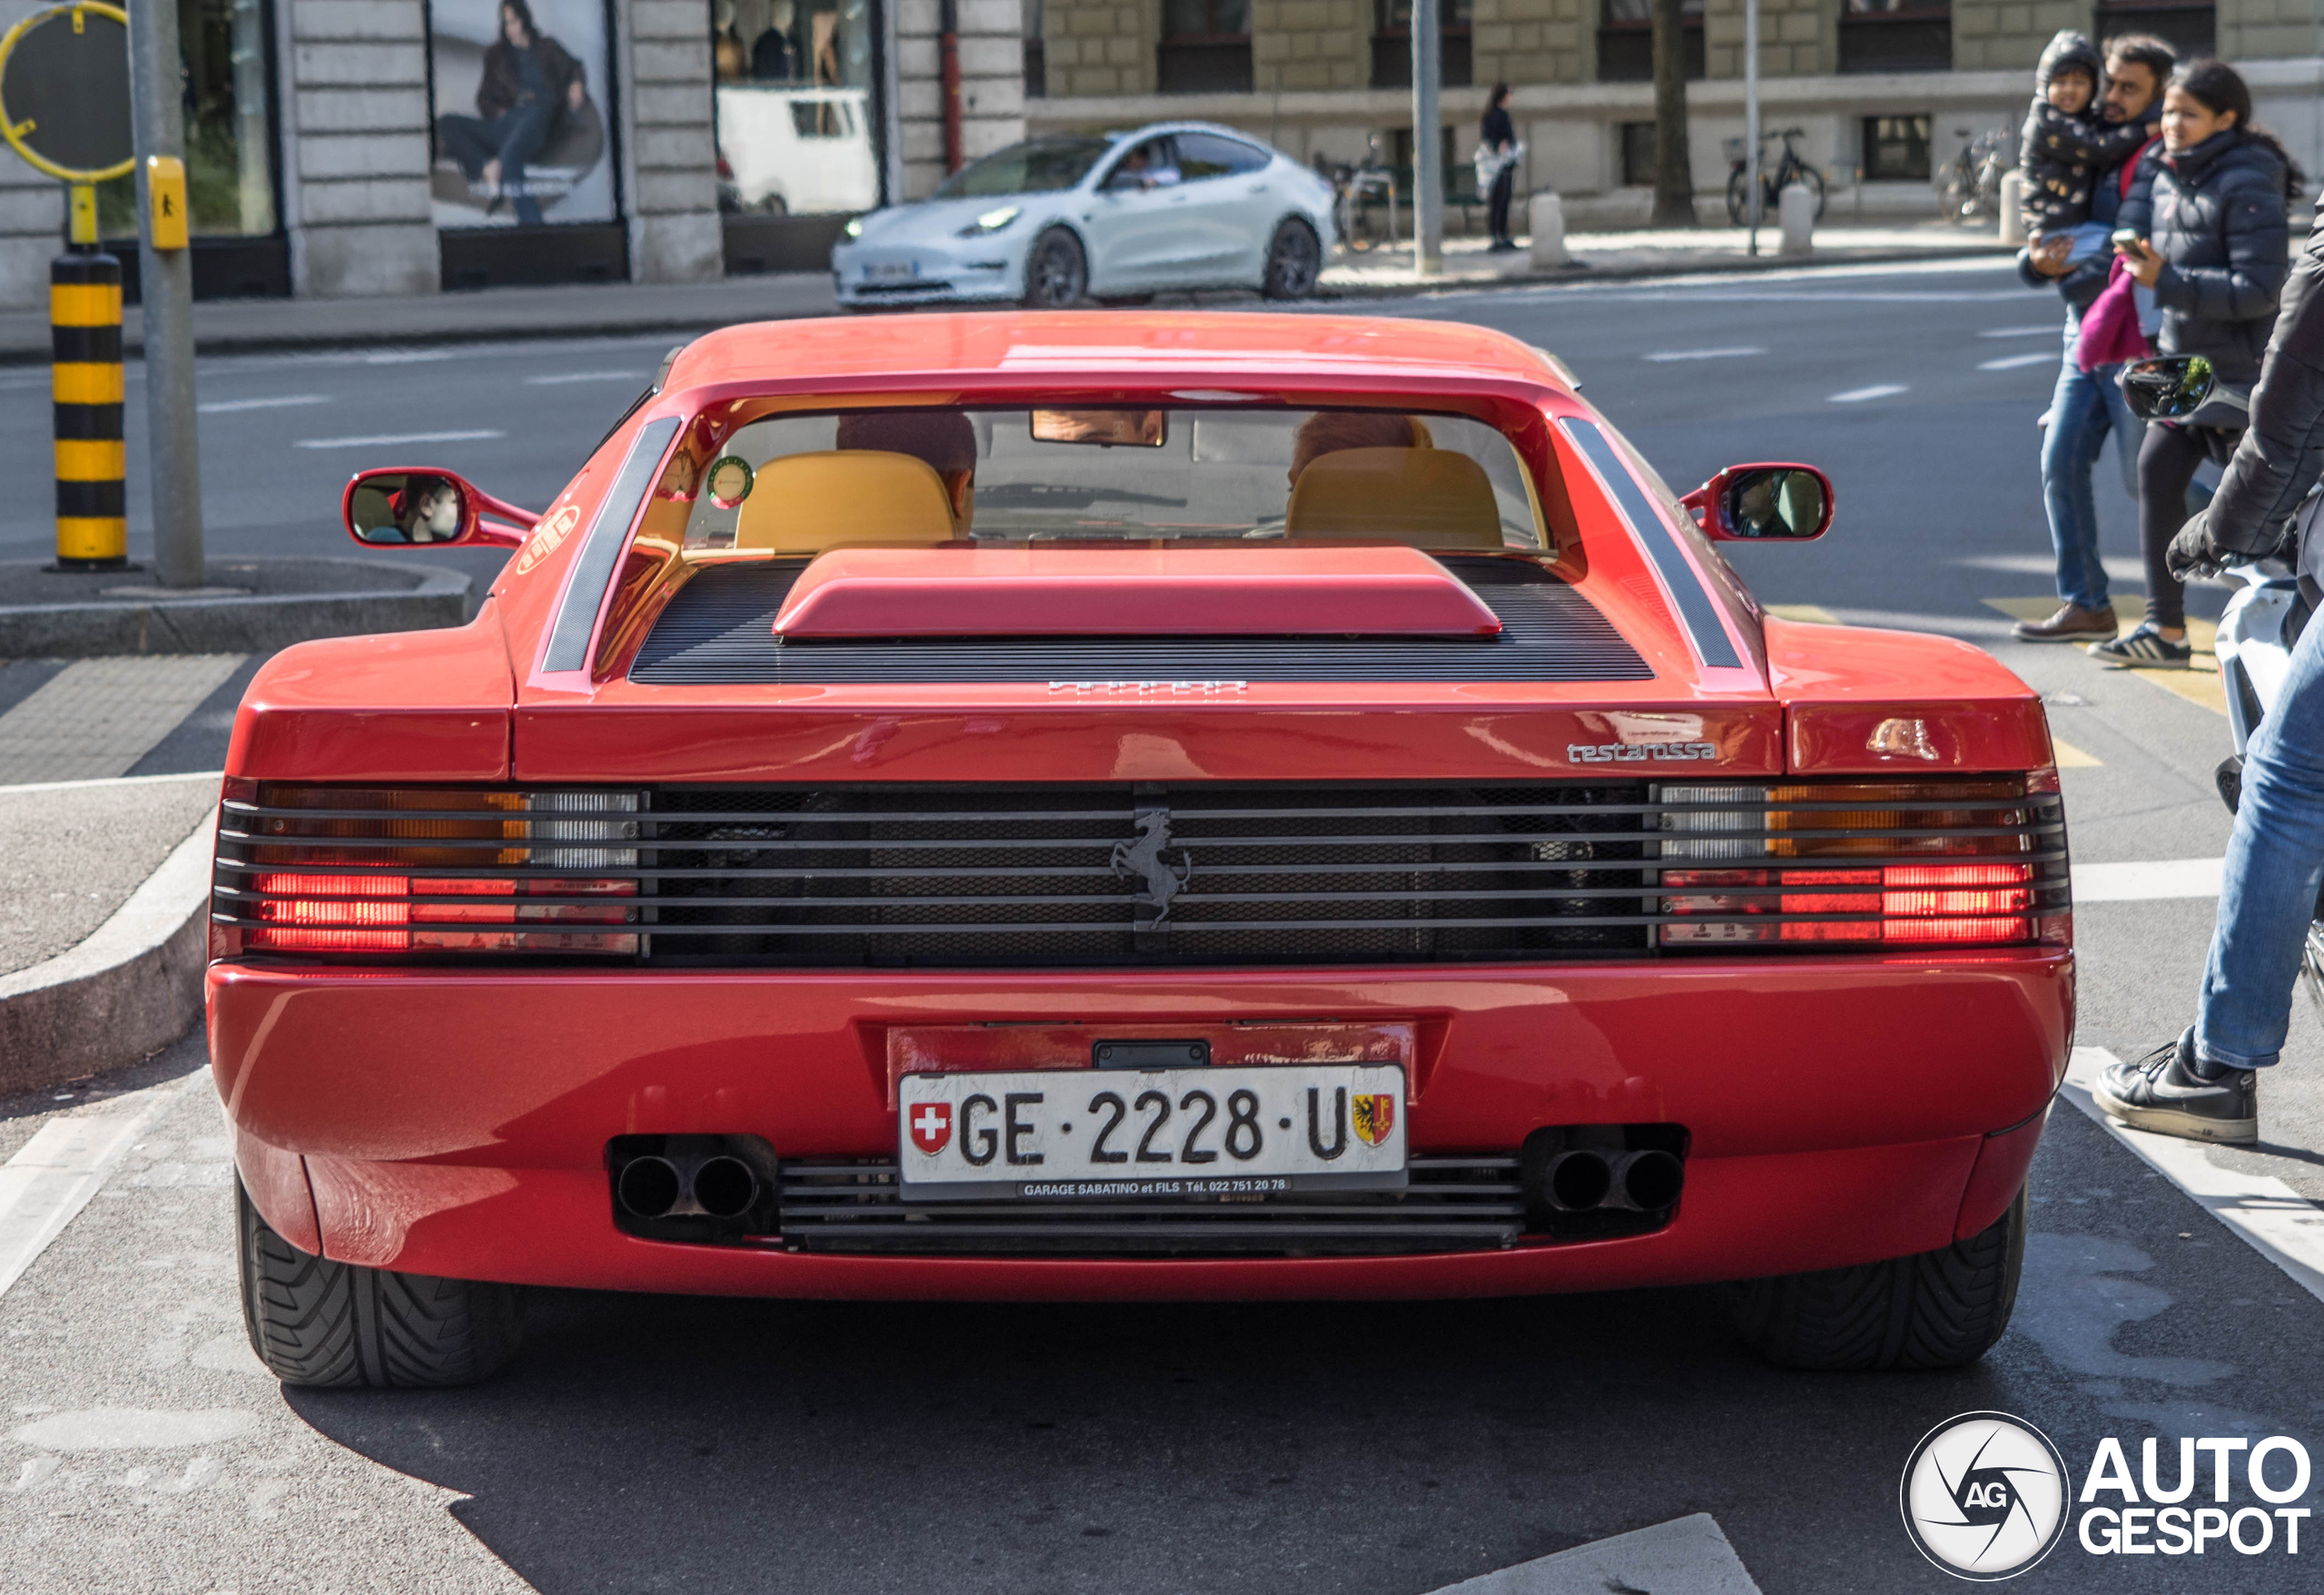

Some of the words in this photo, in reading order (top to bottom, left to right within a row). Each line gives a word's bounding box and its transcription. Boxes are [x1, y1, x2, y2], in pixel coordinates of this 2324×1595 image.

[1567, 743, 1715, 763] testarossa
[1024, 1184, 1076, 1196] GARAGE
[1078, 1183, 1138, 1196] SABATINO
[1141, 1183, 1153, 1194] et
[1156, 1182, 1180, 1194] FILS
[1209, 1180, 1229, 1192] 022
[1232, 1180, 1252, 1192] 751
[1255, 1179, 1269, 1191] 20
[1272, 1179, 1286, 1191] 78
